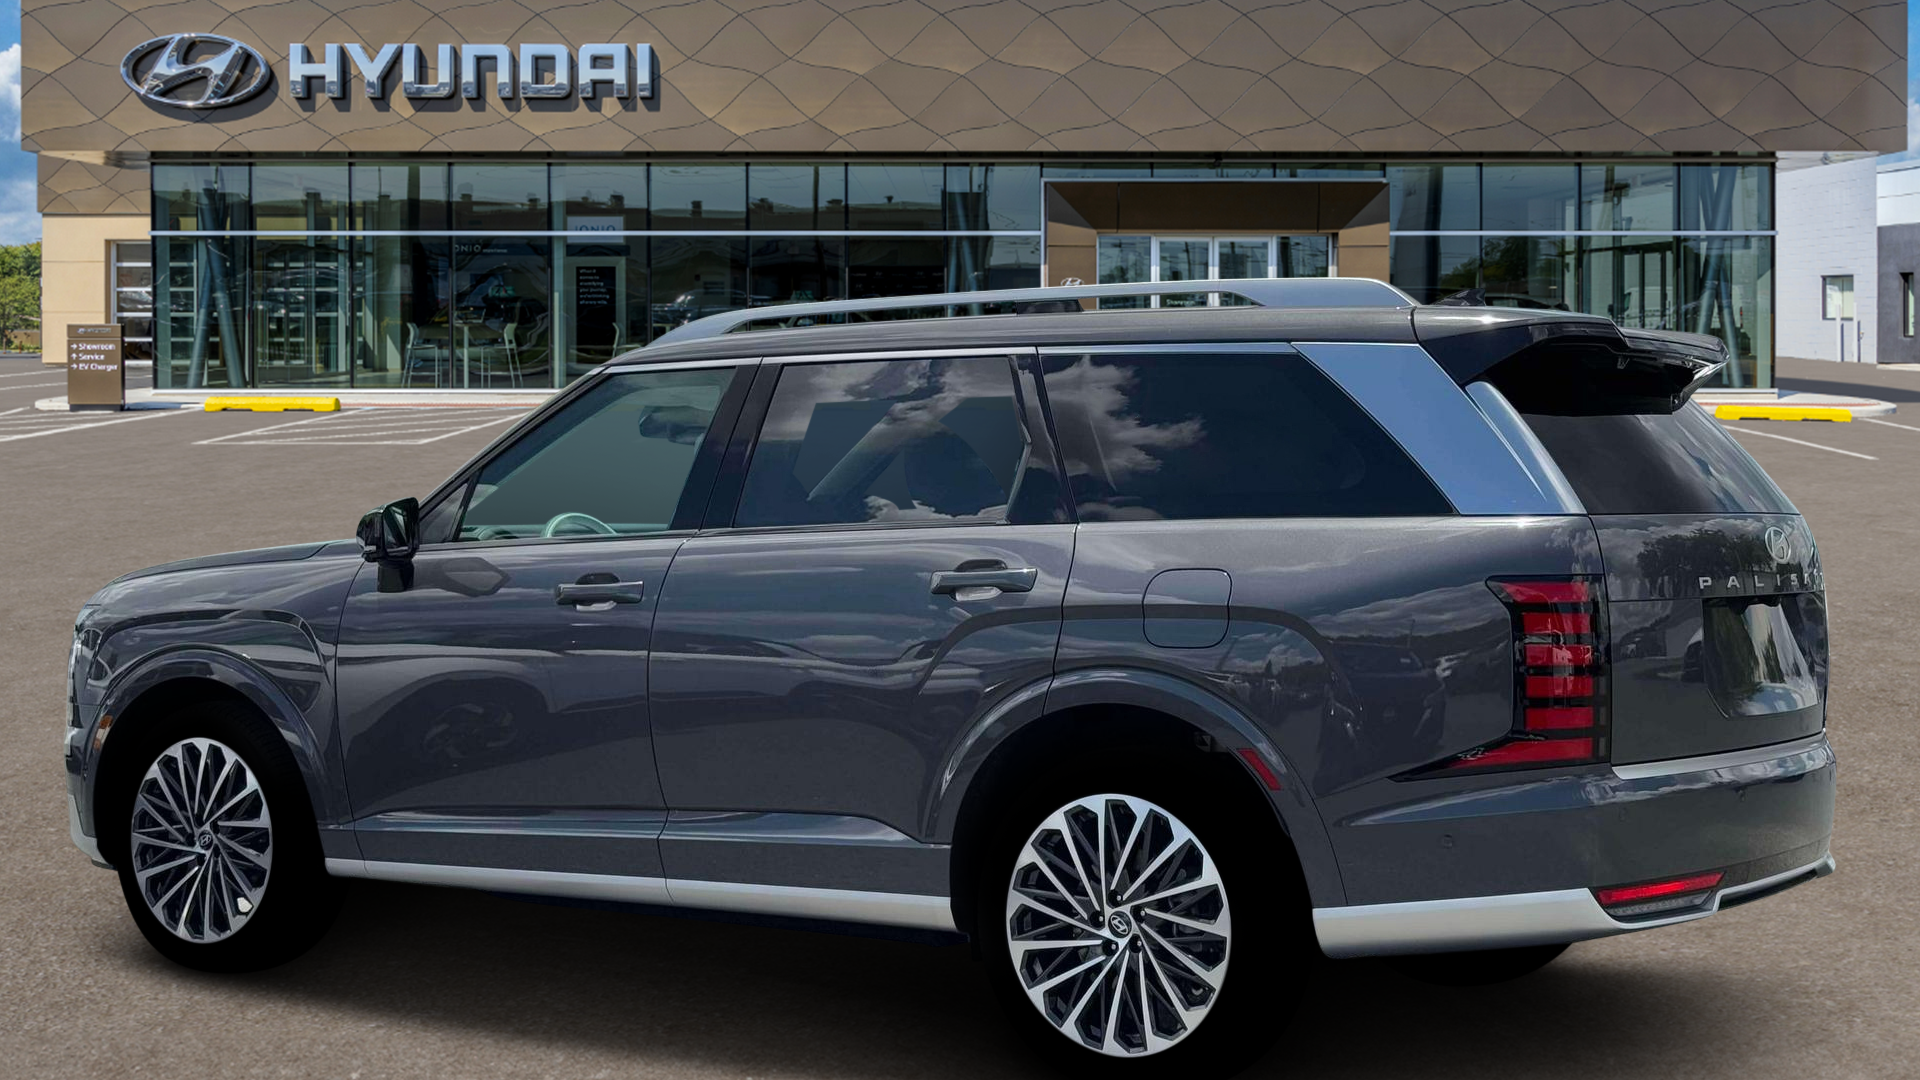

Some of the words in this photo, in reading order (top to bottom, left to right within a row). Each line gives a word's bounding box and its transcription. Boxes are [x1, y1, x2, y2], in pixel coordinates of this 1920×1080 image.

[289, 43, 653, 98] HYUNDAI
[78, 353, 105, 361] Service
[90, 363, 118, 372] Charger
